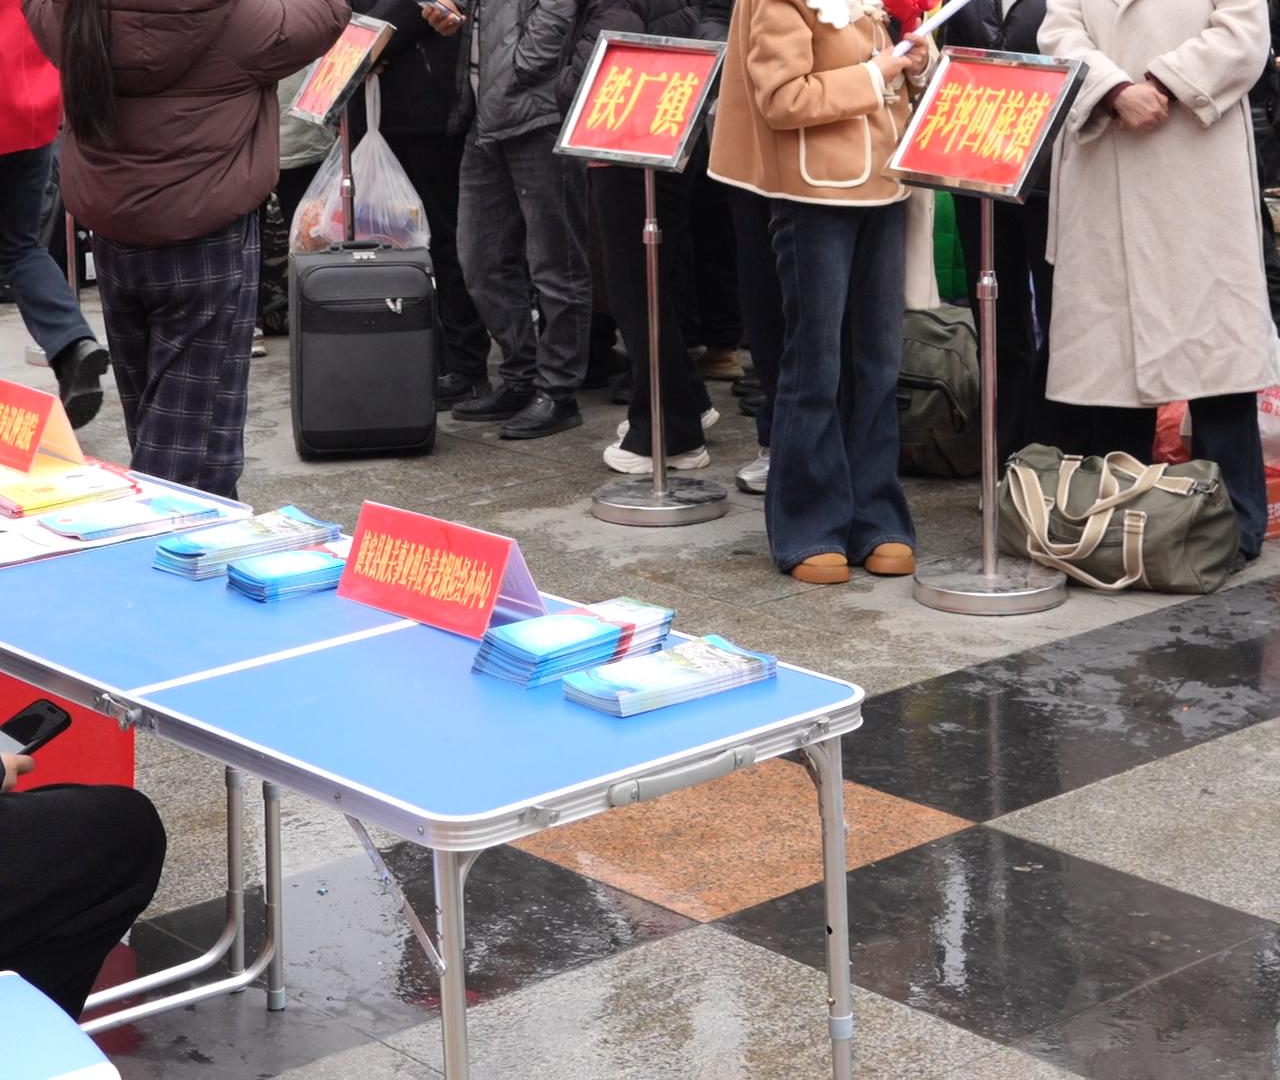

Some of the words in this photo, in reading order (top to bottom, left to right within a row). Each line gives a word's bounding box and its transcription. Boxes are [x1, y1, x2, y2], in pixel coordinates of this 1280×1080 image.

[586, 66, 699, 138] 铁厂镇
[916, 82, 1051, 163] 茅坪回族镇
